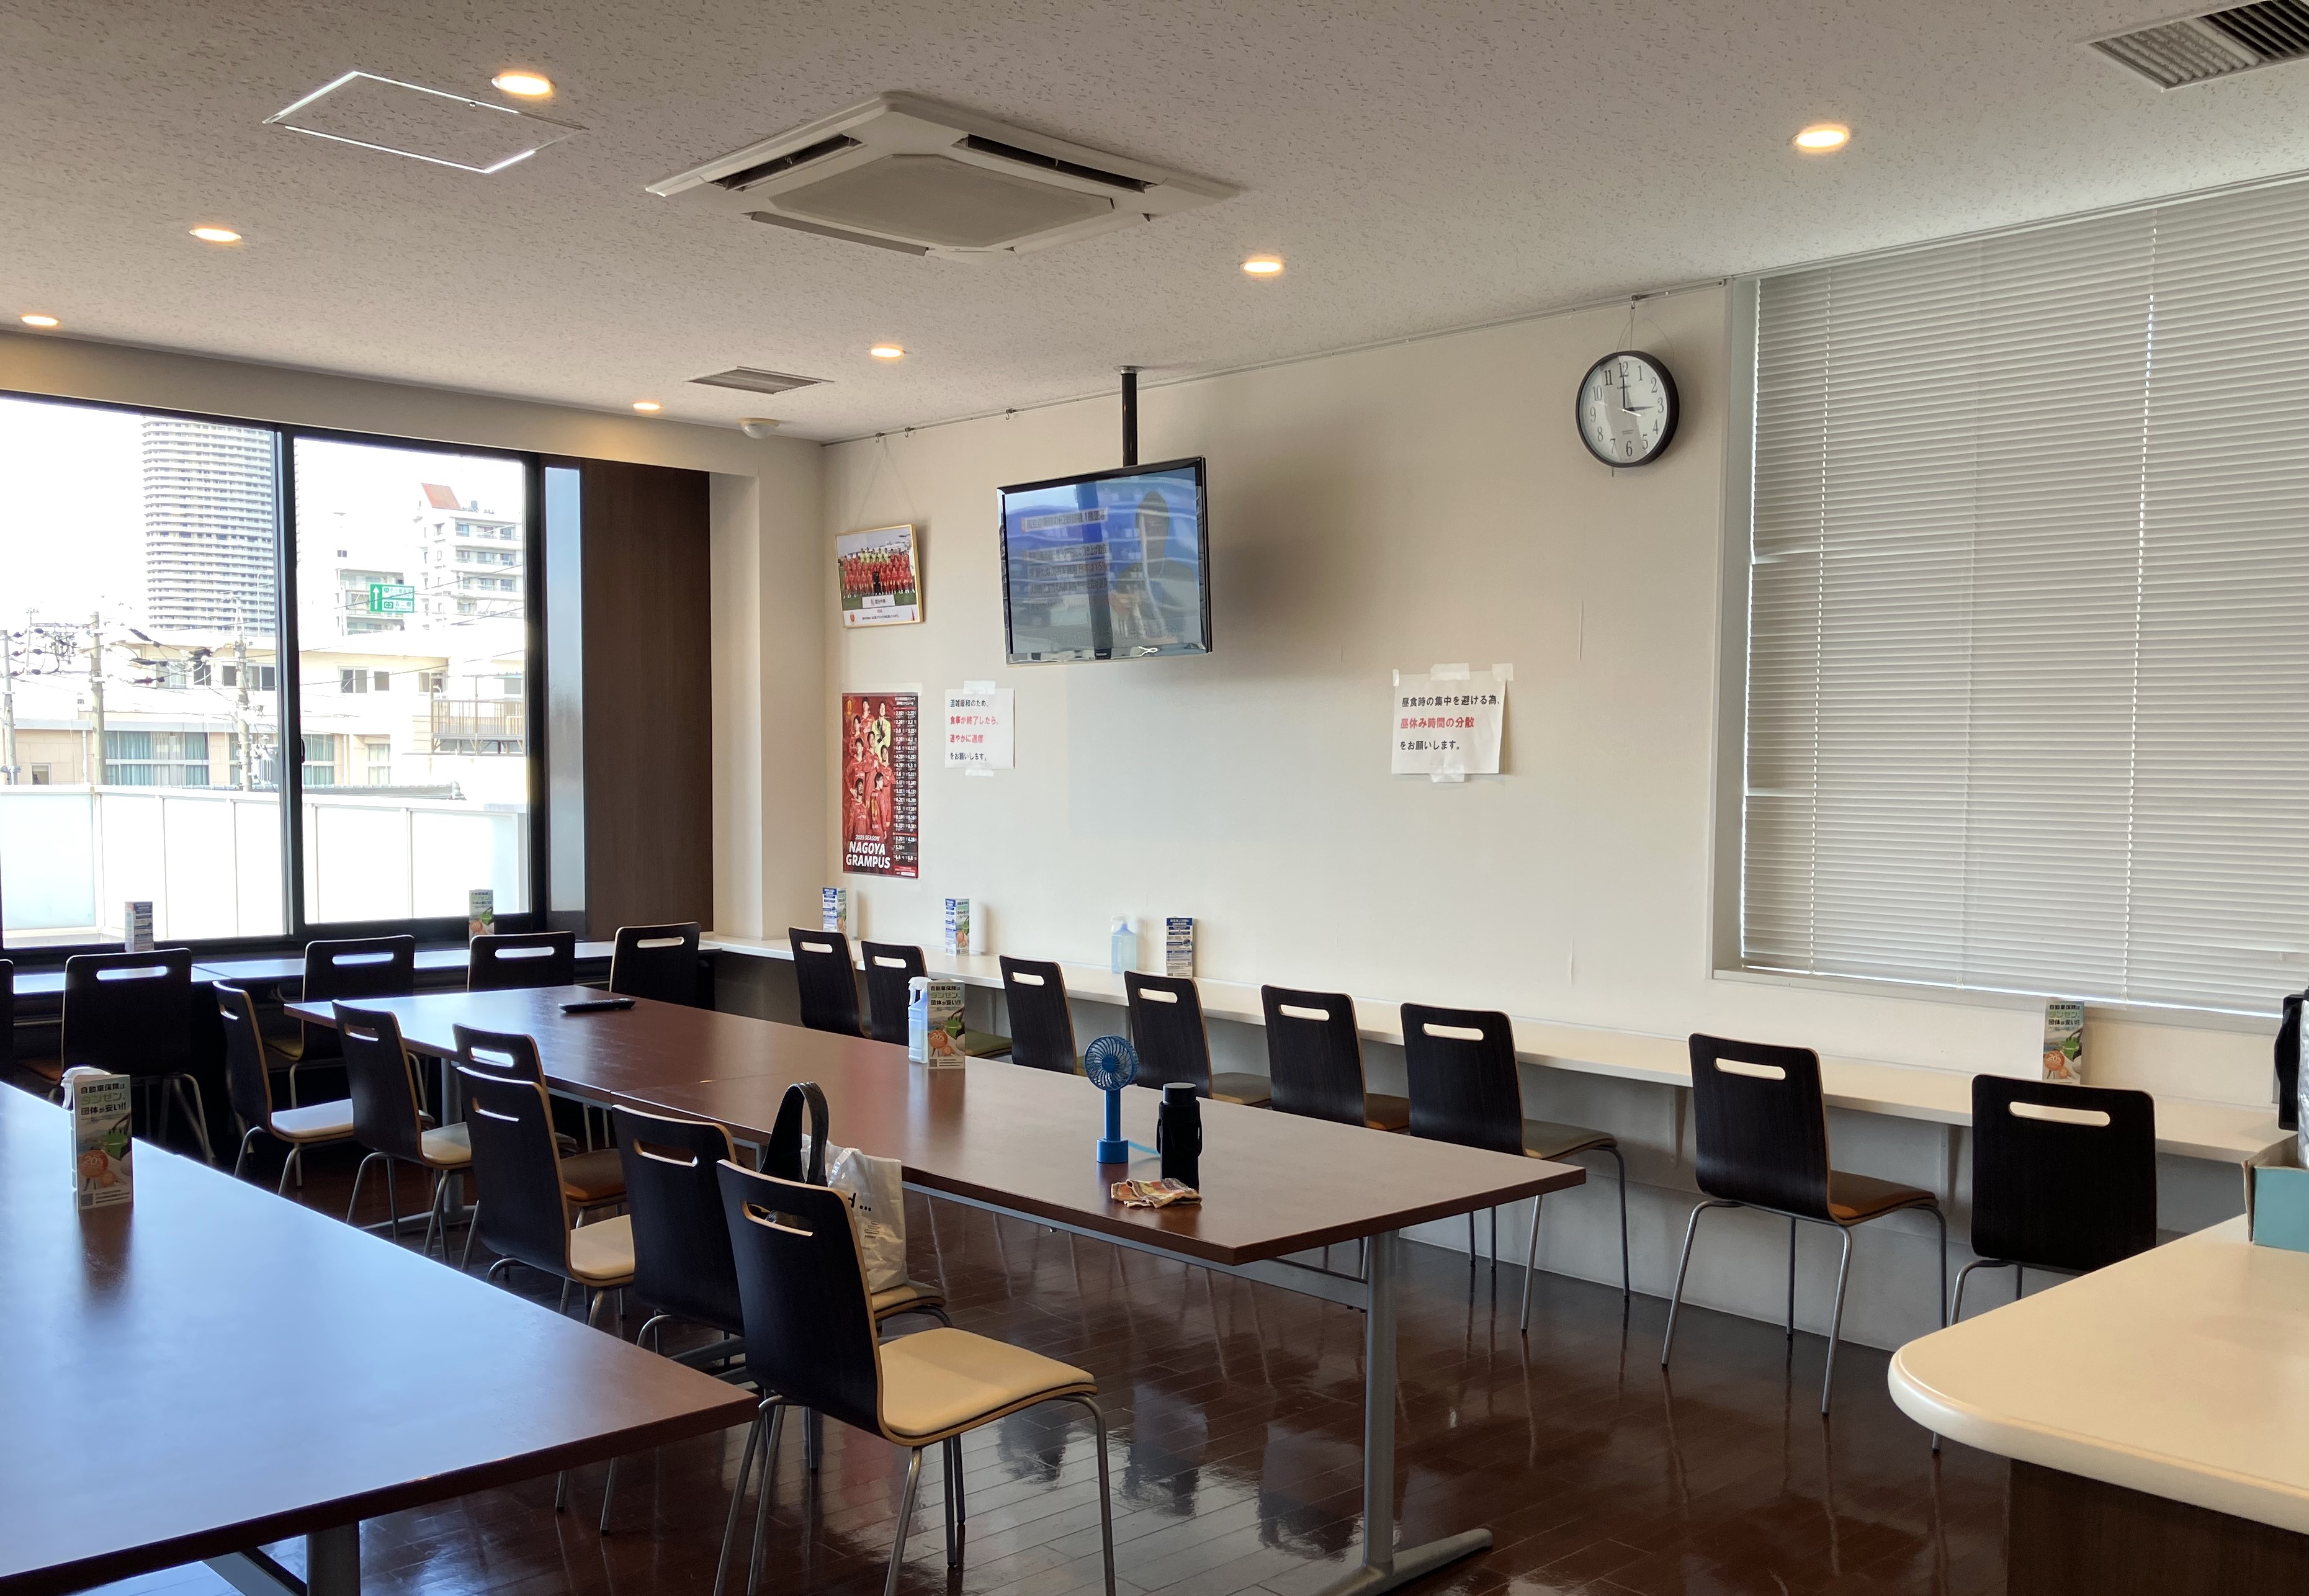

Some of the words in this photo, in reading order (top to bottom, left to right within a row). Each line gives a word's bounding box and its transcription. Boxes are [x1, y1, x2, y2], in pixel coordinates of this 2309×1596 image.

[1603, 369, 1613, 386] 11
[1618, 362, 1629, 378] 12
[1638, 365, 1643, 381] 1
[1592, 385, 1603, 401] 10
[1651, 377, 1657, 393] 2
[1657, 397, 1664, 413] 3
[1590, 406, 1597, 423] 9
[1597, 426, 1604, 442] 8
[1652, 419, 1659, 434] 4
[1610, 438, 1616, 454] 7
[1626, 440, 1633, 456] 6
[1642, 434, 1648, 450] 5
[1401, 695, 1500, 707] 昼食時の集中を避ける為、
[950, 716, 998, 725] 食事が終了したら、
[1401, 717, 1474, 729] 昼休み時間の分散
[1400, 740, 1459, 750] をお願いします。
[950, 753, 986, 761] をお願いします。
[849, 841, 885, 855] NAGOYA
[846, 854, 890, 869] GRAMPUS
